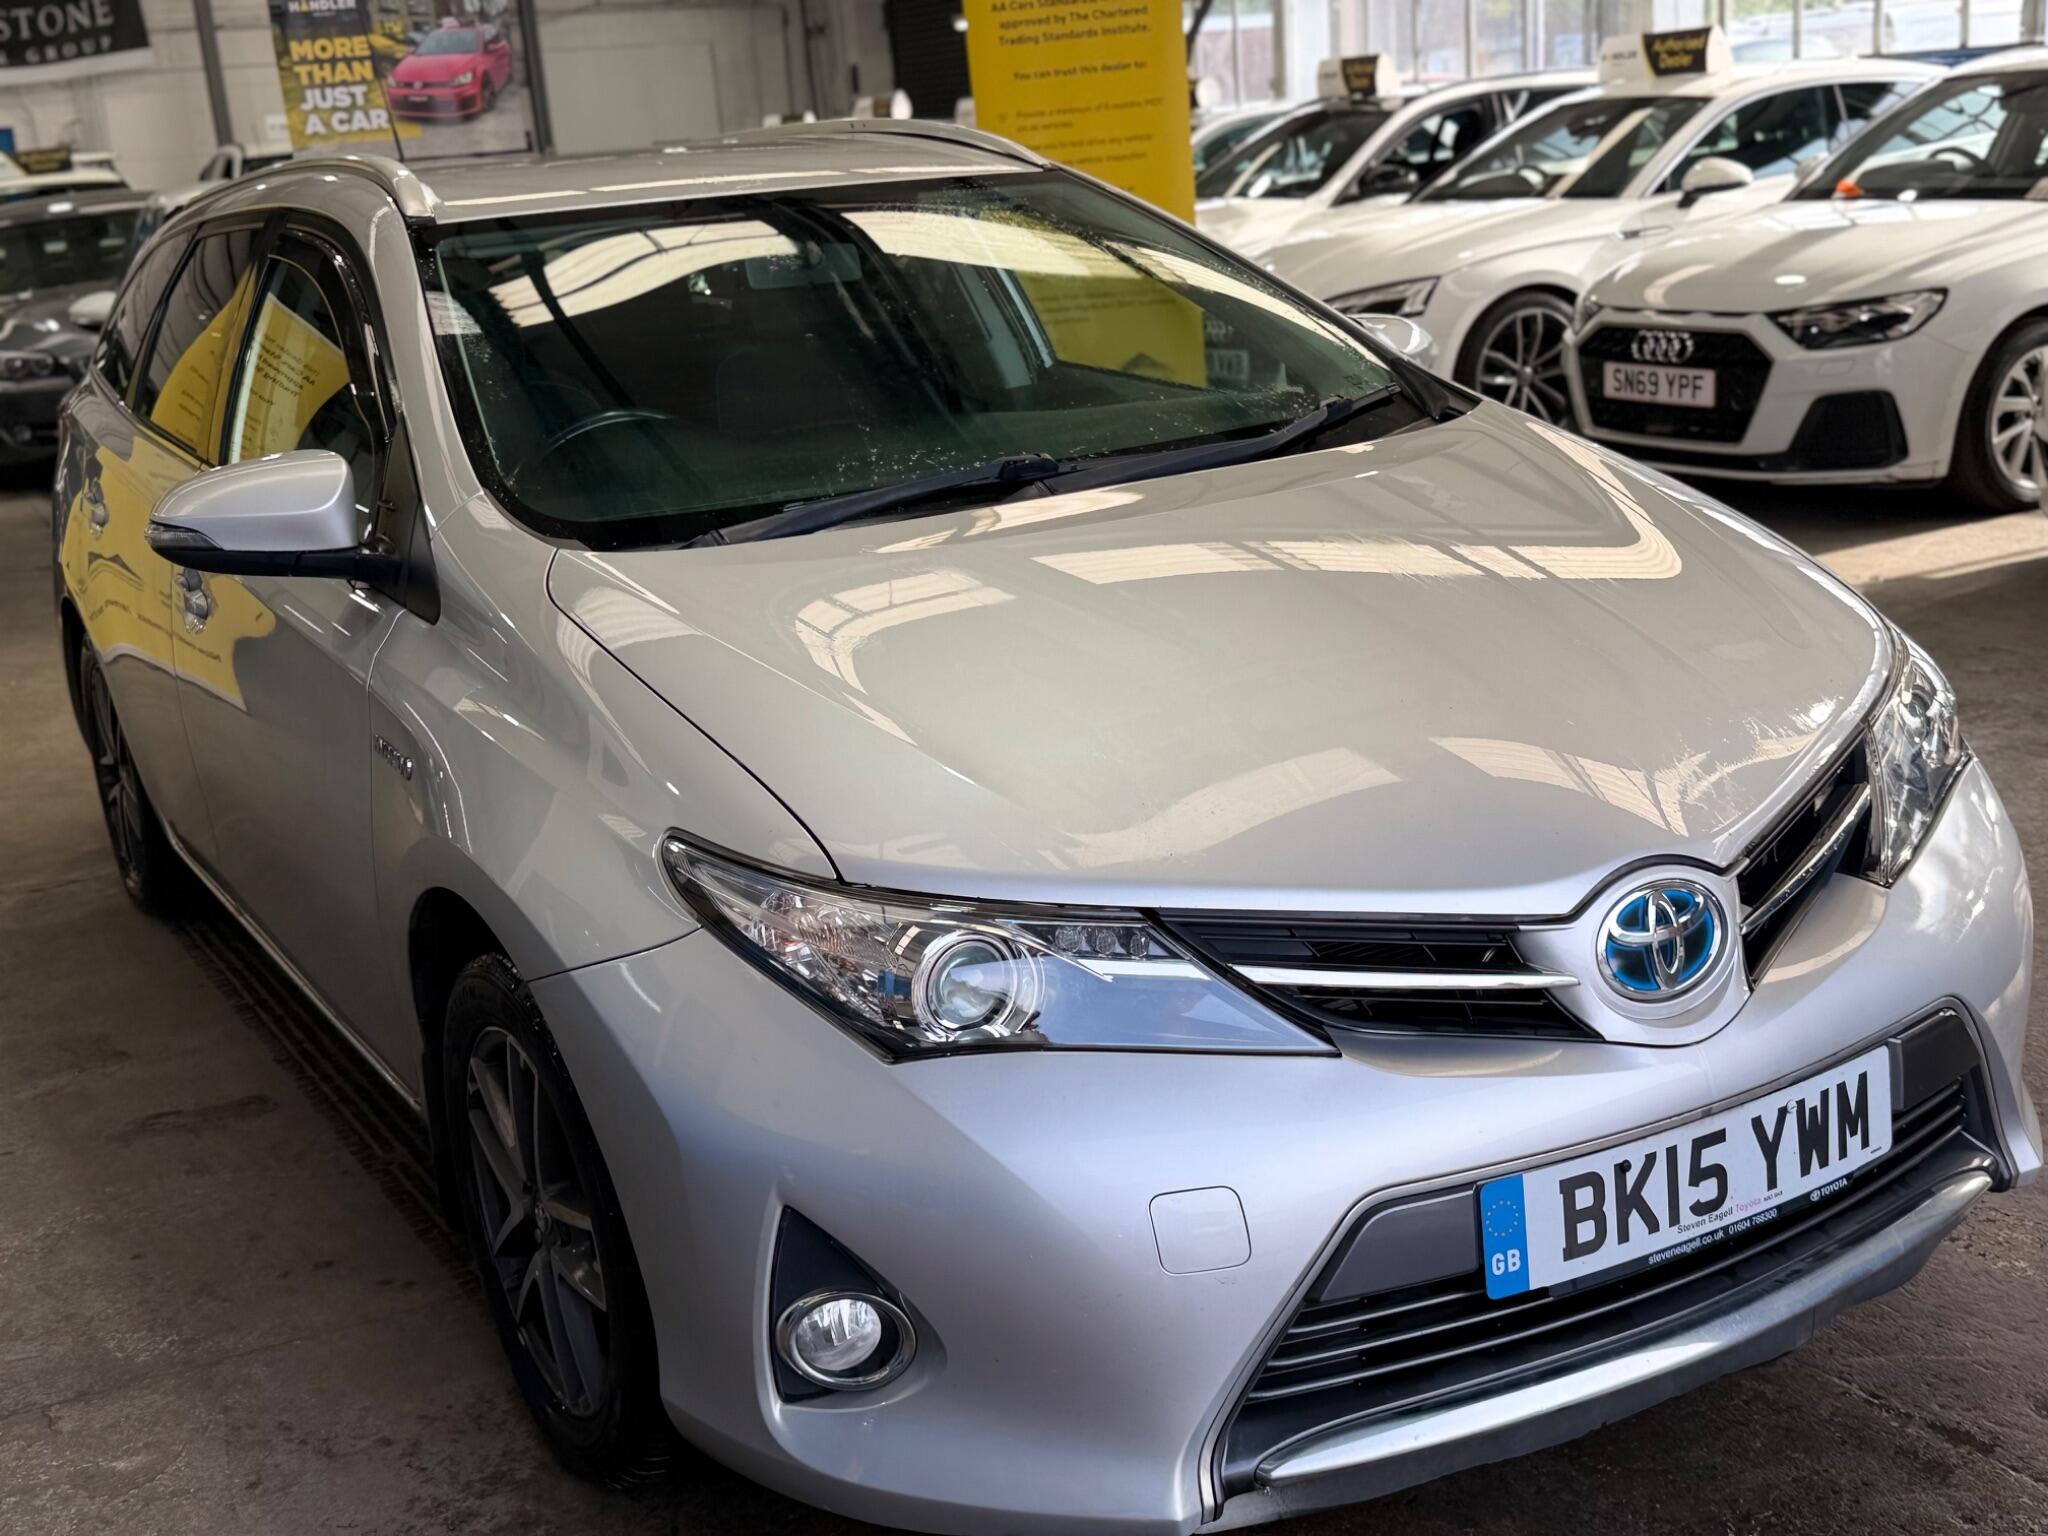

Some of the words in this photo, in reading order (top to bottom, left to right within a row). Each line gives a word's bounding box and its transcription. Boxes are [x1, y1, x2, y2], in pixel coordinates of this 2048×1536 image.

[289, 0, 356, 12] HANDLER
[991, 2, 1006, 13] AA
[1009, 0, 1034, 11] Cars
[1000, 16, 1051, 30] approved
[1053, 14, 1066, 25] by
[1069, 12, 1089, 22] The
[1092, 5, 1149, 20] Chartered
[290, 35, 371, 61] MORE
[998, 32, 1040, 46] Trading
[1042, 28, 1098, 41] Standards
[293, 60, 375, 85] THAN
[1014, 71, 1031, 80] You
[1034, 70, 1051, 80] can
[1054, 66, 1077, 77] trust
[300, 84, 367, 110] JUST
[304, 113, 326, 136] A
[331, 108, 389, 134] CAR
[1613, 368, 1659, 397] SN69
[1665, 373, 1705, 399] YPF
[1559, 1128, 1729, 1263] BK15
[1752, 1071, 1870, 1192] YWM
[1820, 1177, 1848, 1197] TOYOTA
[1677, 1217, 1706, 1234] Steven
[1708, 1206, 1733, 1224] Eagell
[1736, 1197, 1761, 1214] Toyota
[1648, 1230, 1724, 1265] steveneagell.co.uk
[1728, 1217, 1751, 1234] 01604
[1492, 1249, 1521, 1276] GB
